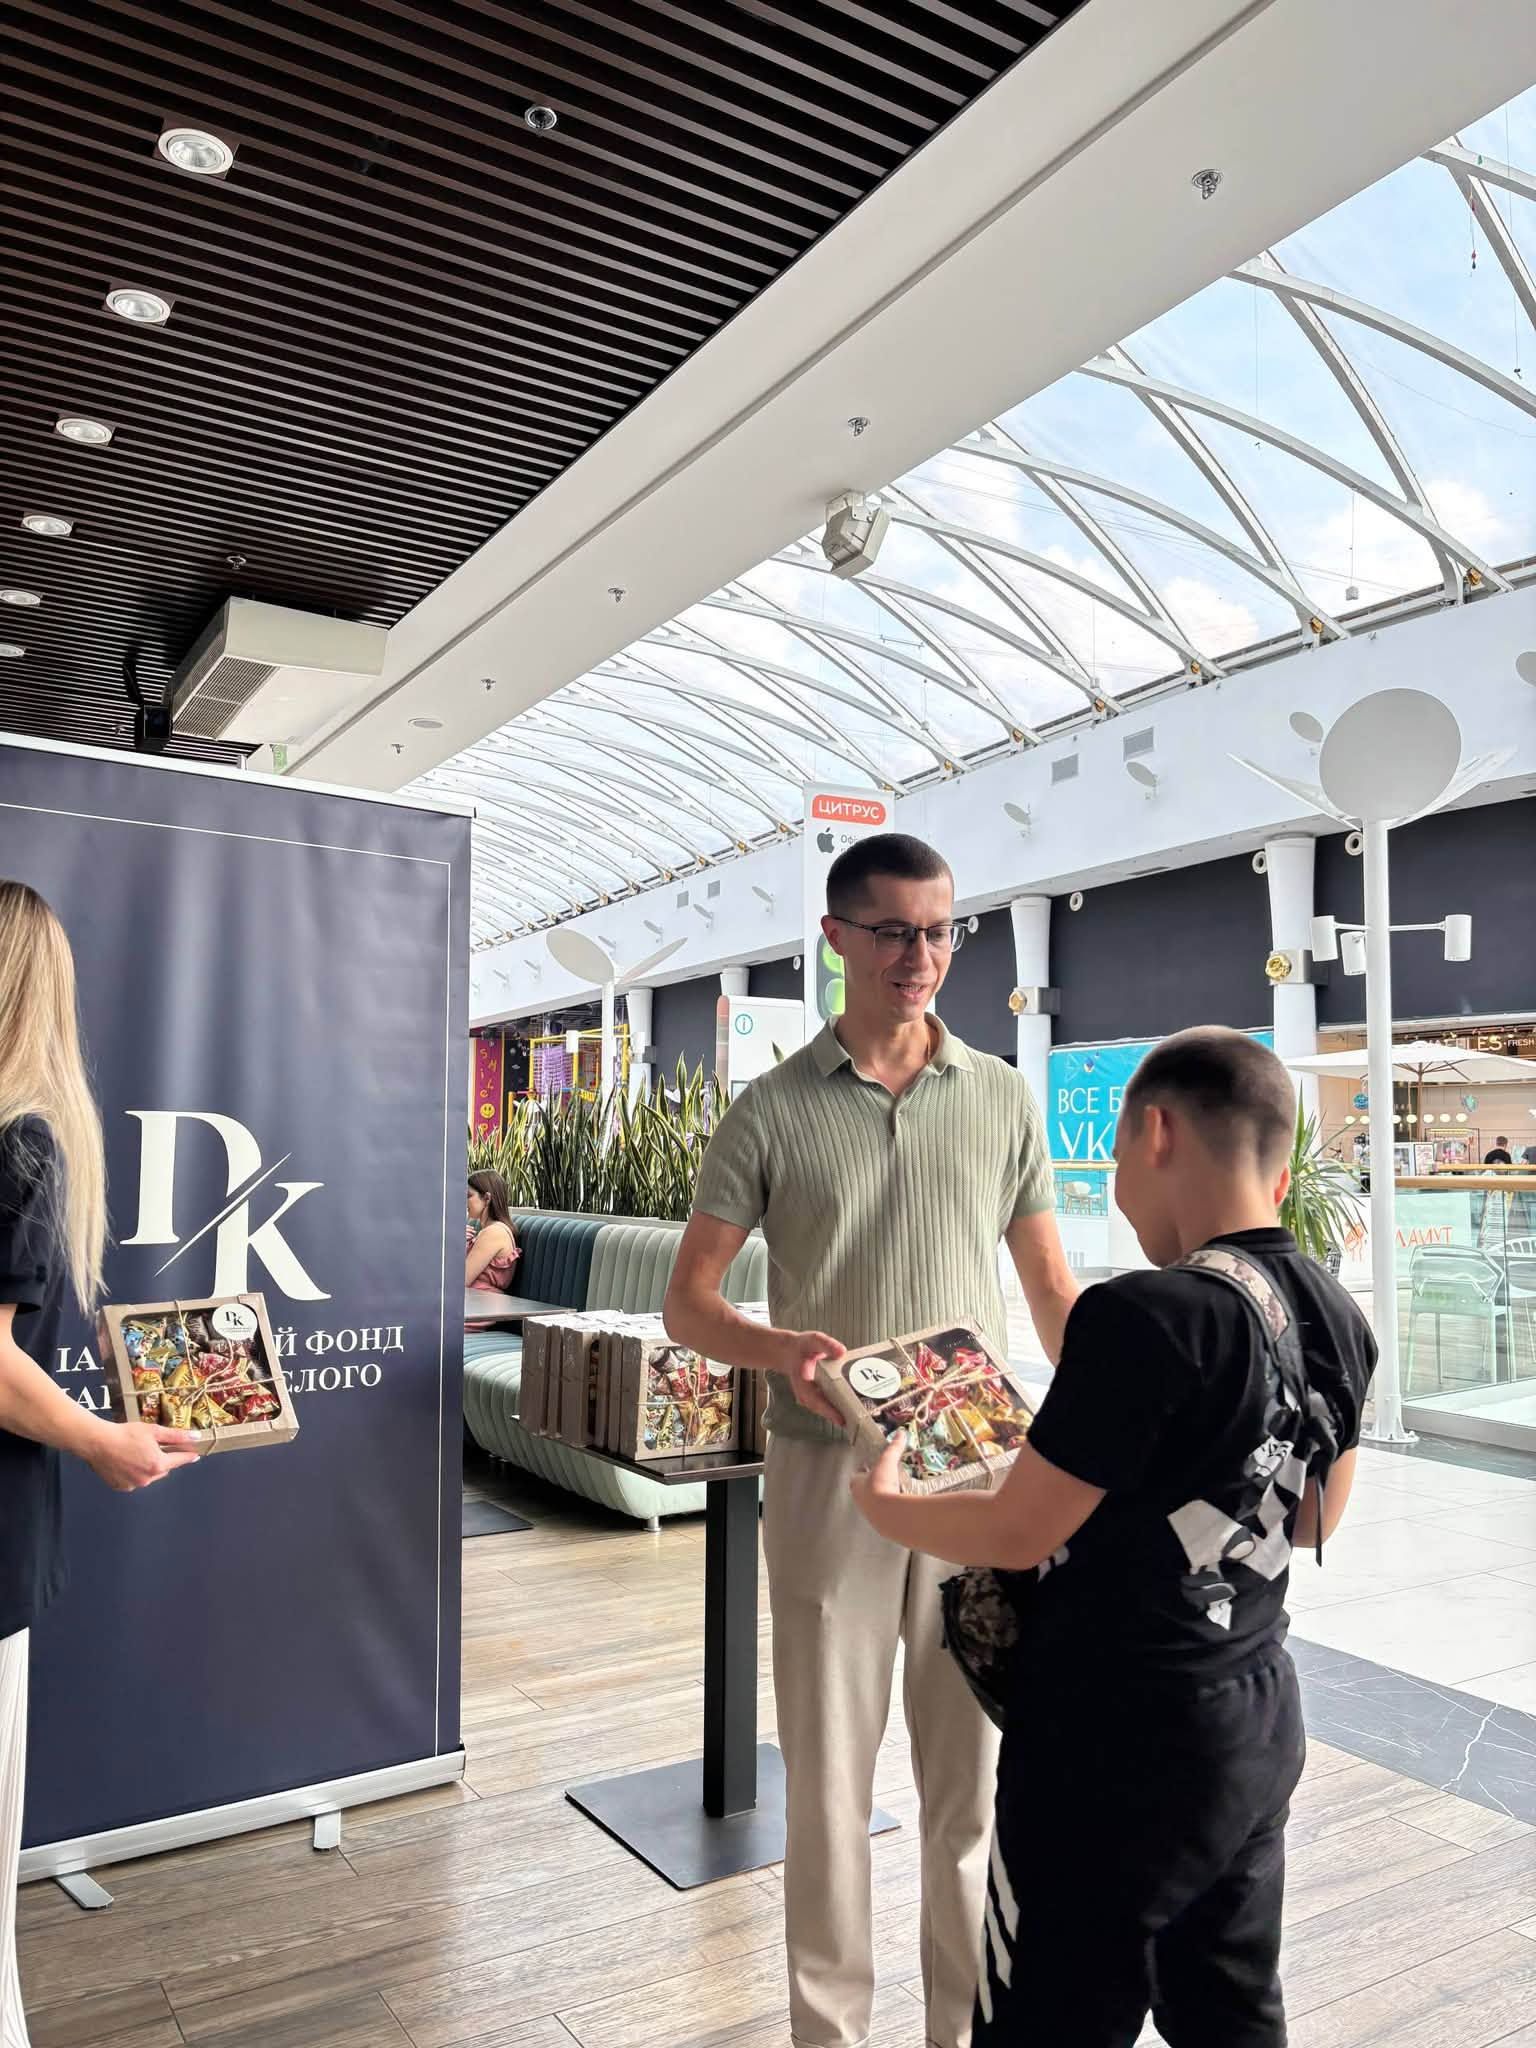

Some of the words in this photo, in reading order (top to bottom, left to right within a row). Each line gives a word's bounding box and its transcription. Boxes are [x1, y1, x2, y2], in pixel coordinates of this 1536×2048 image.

[818, 799, 880, 820] ЦИТРУС
[1058, 1087, 1100, 1114] ВСЕ
[305, 1326, 404, 1355] ФОНД
